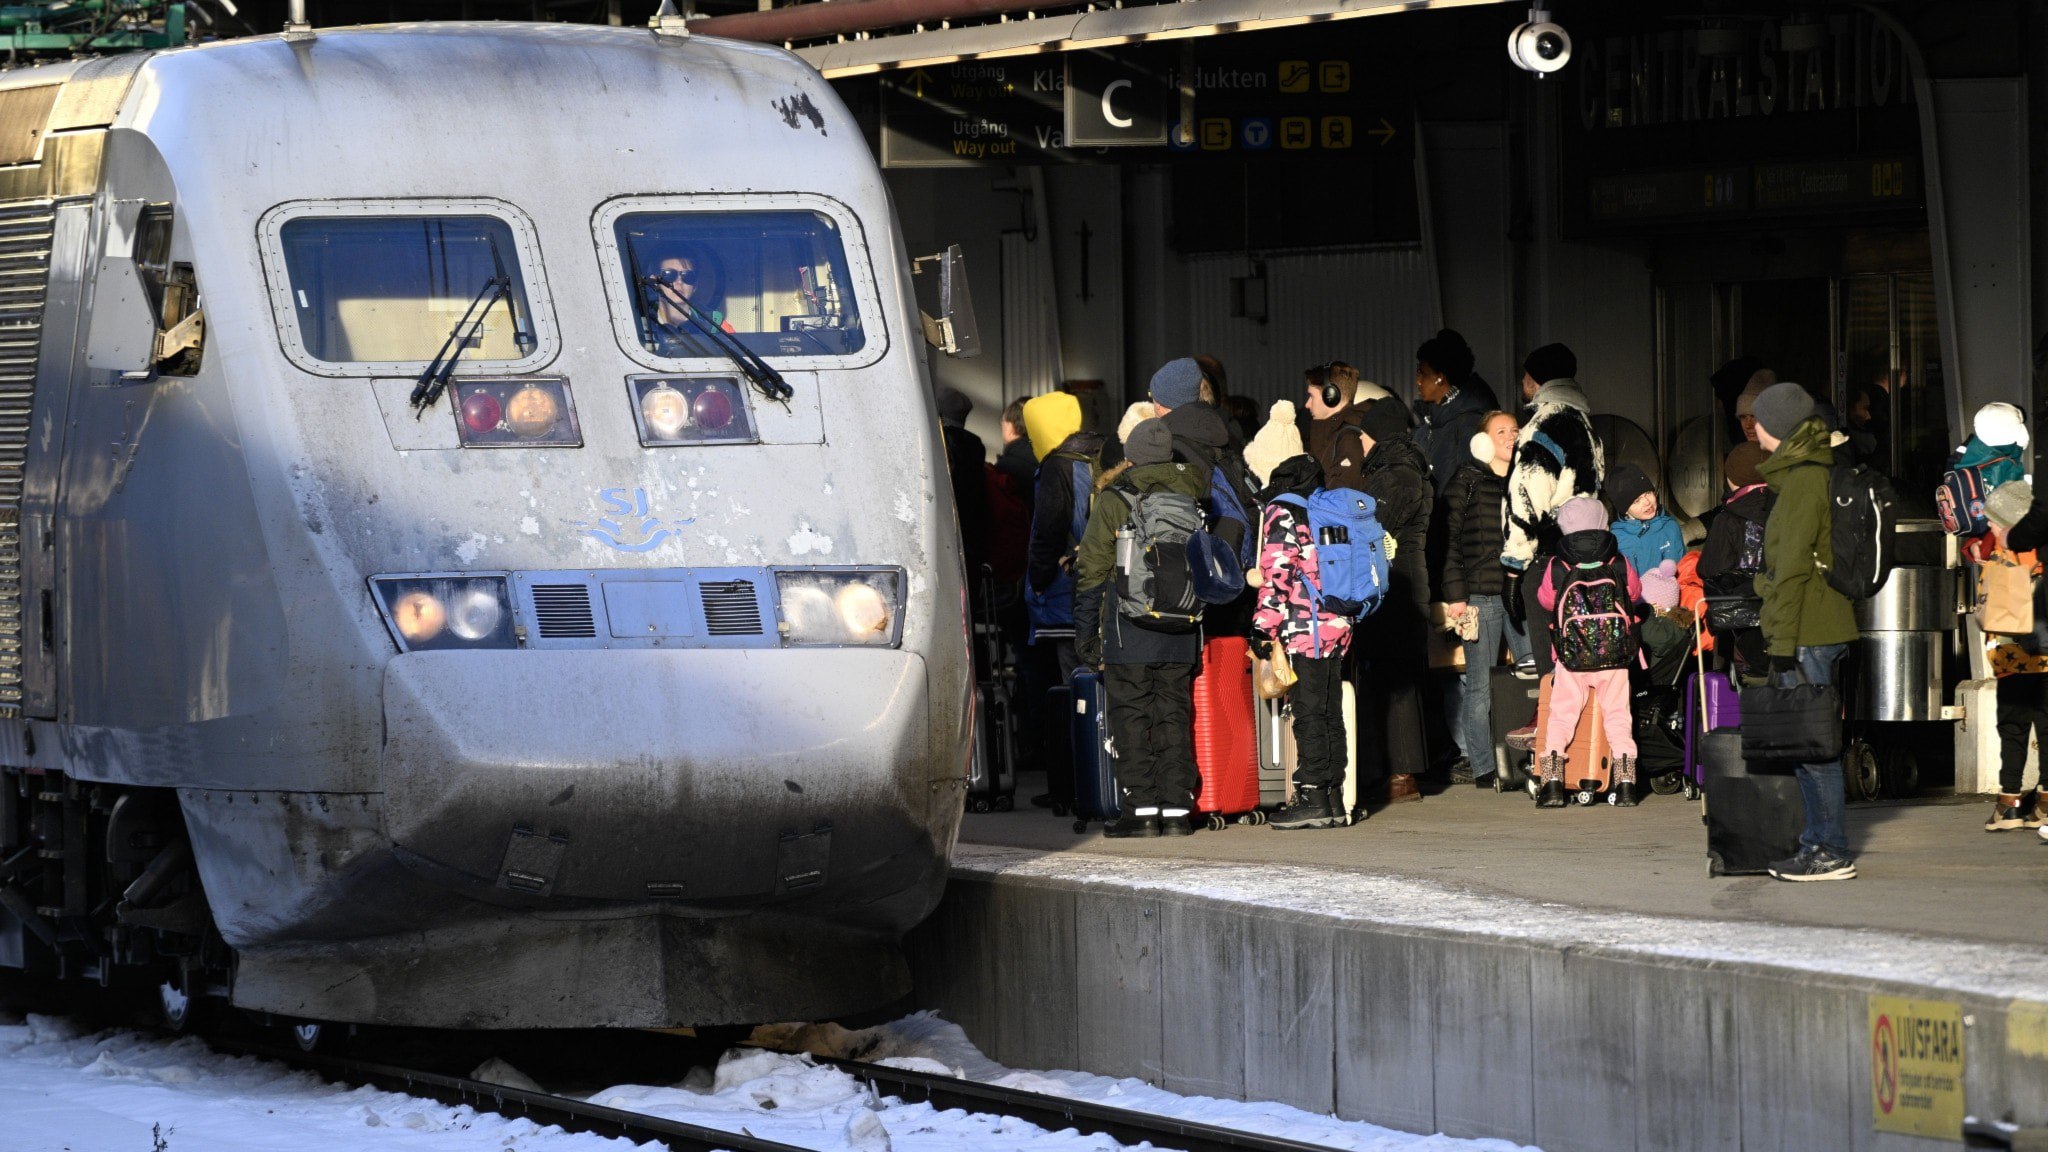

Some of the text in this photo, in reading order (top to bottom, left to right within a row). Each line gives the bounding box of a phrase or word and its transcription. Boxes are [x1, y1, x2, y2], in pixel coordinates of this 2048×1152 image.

[951, 63, 1005, 81] Utgång
[951, 83, 1014, 101] Way out
[1101, 79, 1133, 128] C
[953, 118, 1008, 139] Utgång
[953, 139, 1016, 158] Way out
[599, 486, 648, 518] SJ
[1896, 1017, 1960, 1063] LIVSFARA
